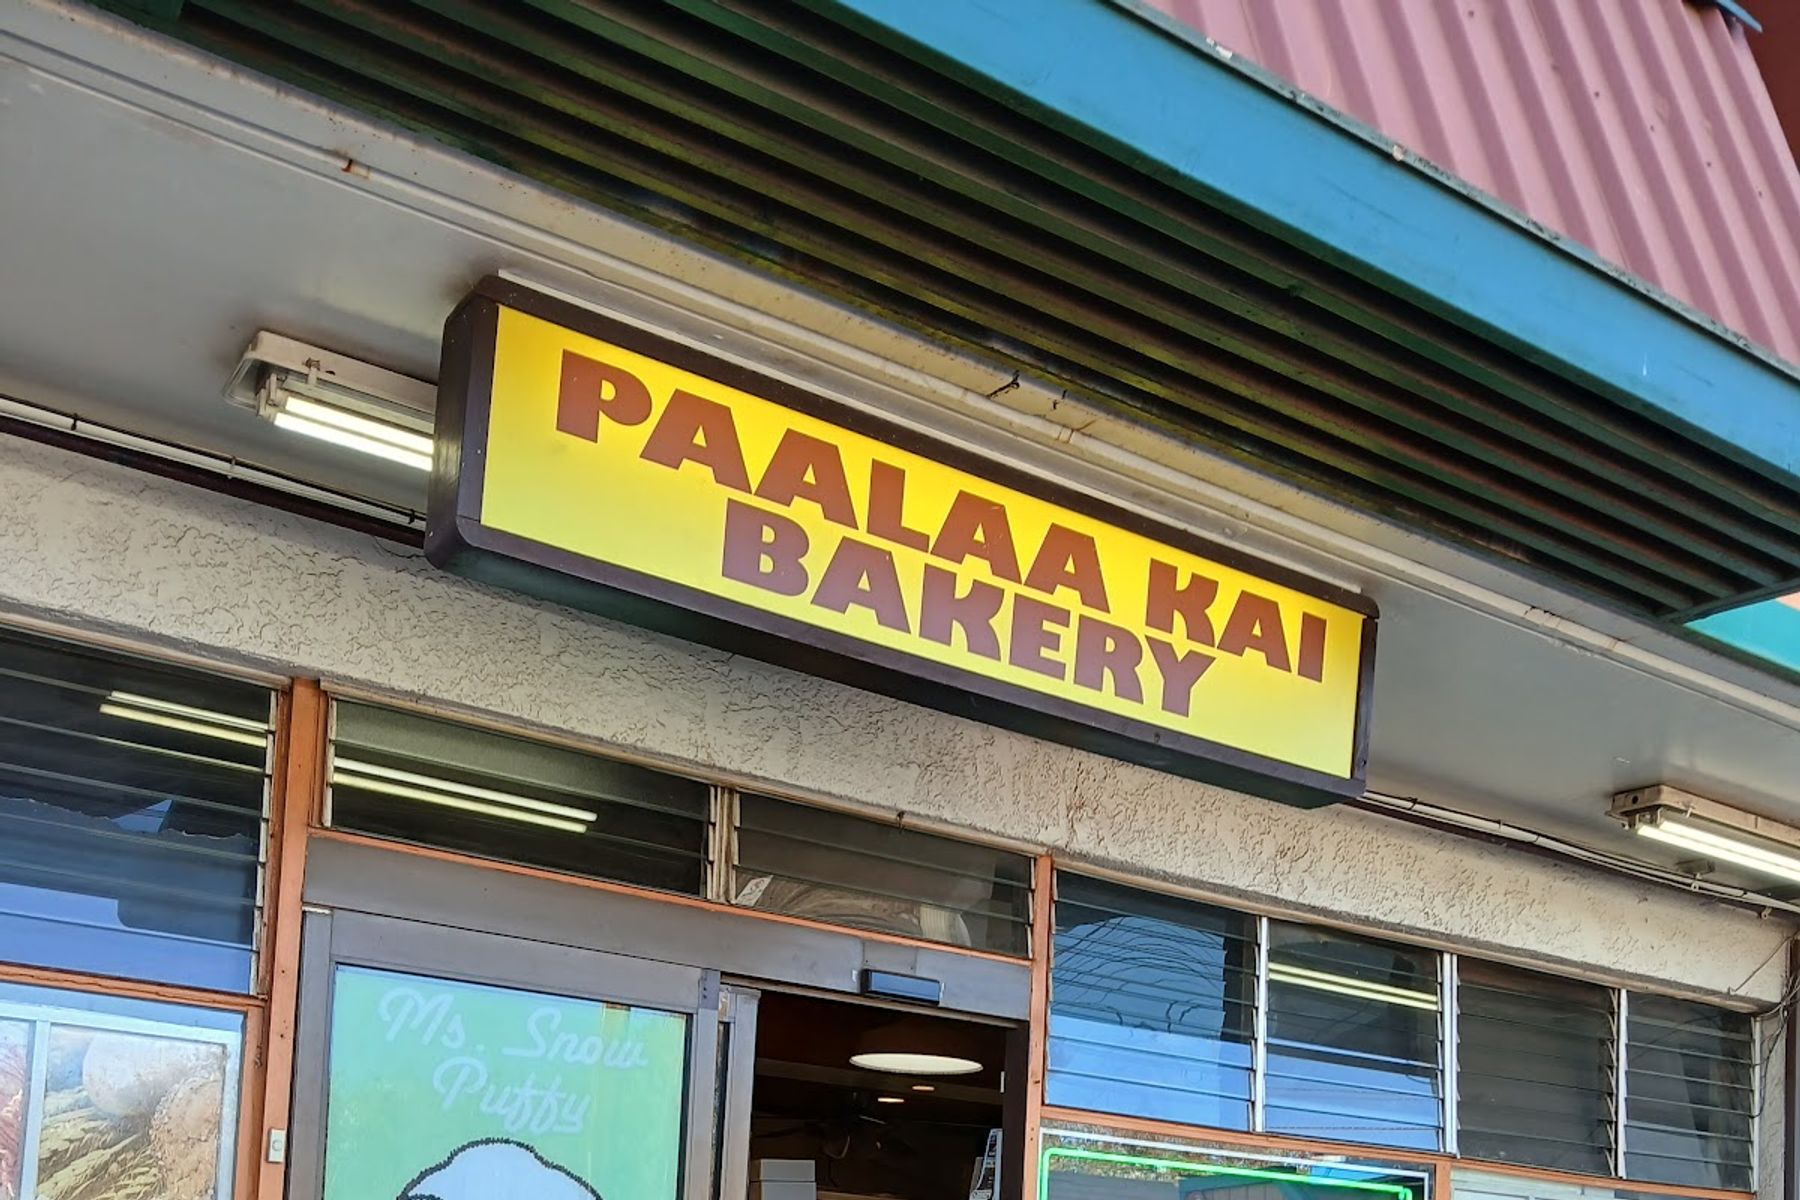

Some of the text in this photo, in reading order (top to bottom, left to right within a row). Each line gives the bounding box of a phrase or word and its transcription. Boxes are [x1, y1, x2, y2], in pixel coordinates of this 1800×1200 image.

[556, 349, 1328, 683] PAALAA KAI
[722, 498, 1216, 718] BAKERY
[432, 1056, 590, 1135] Puffy
[503, 1007, 648, 1068] Snow
